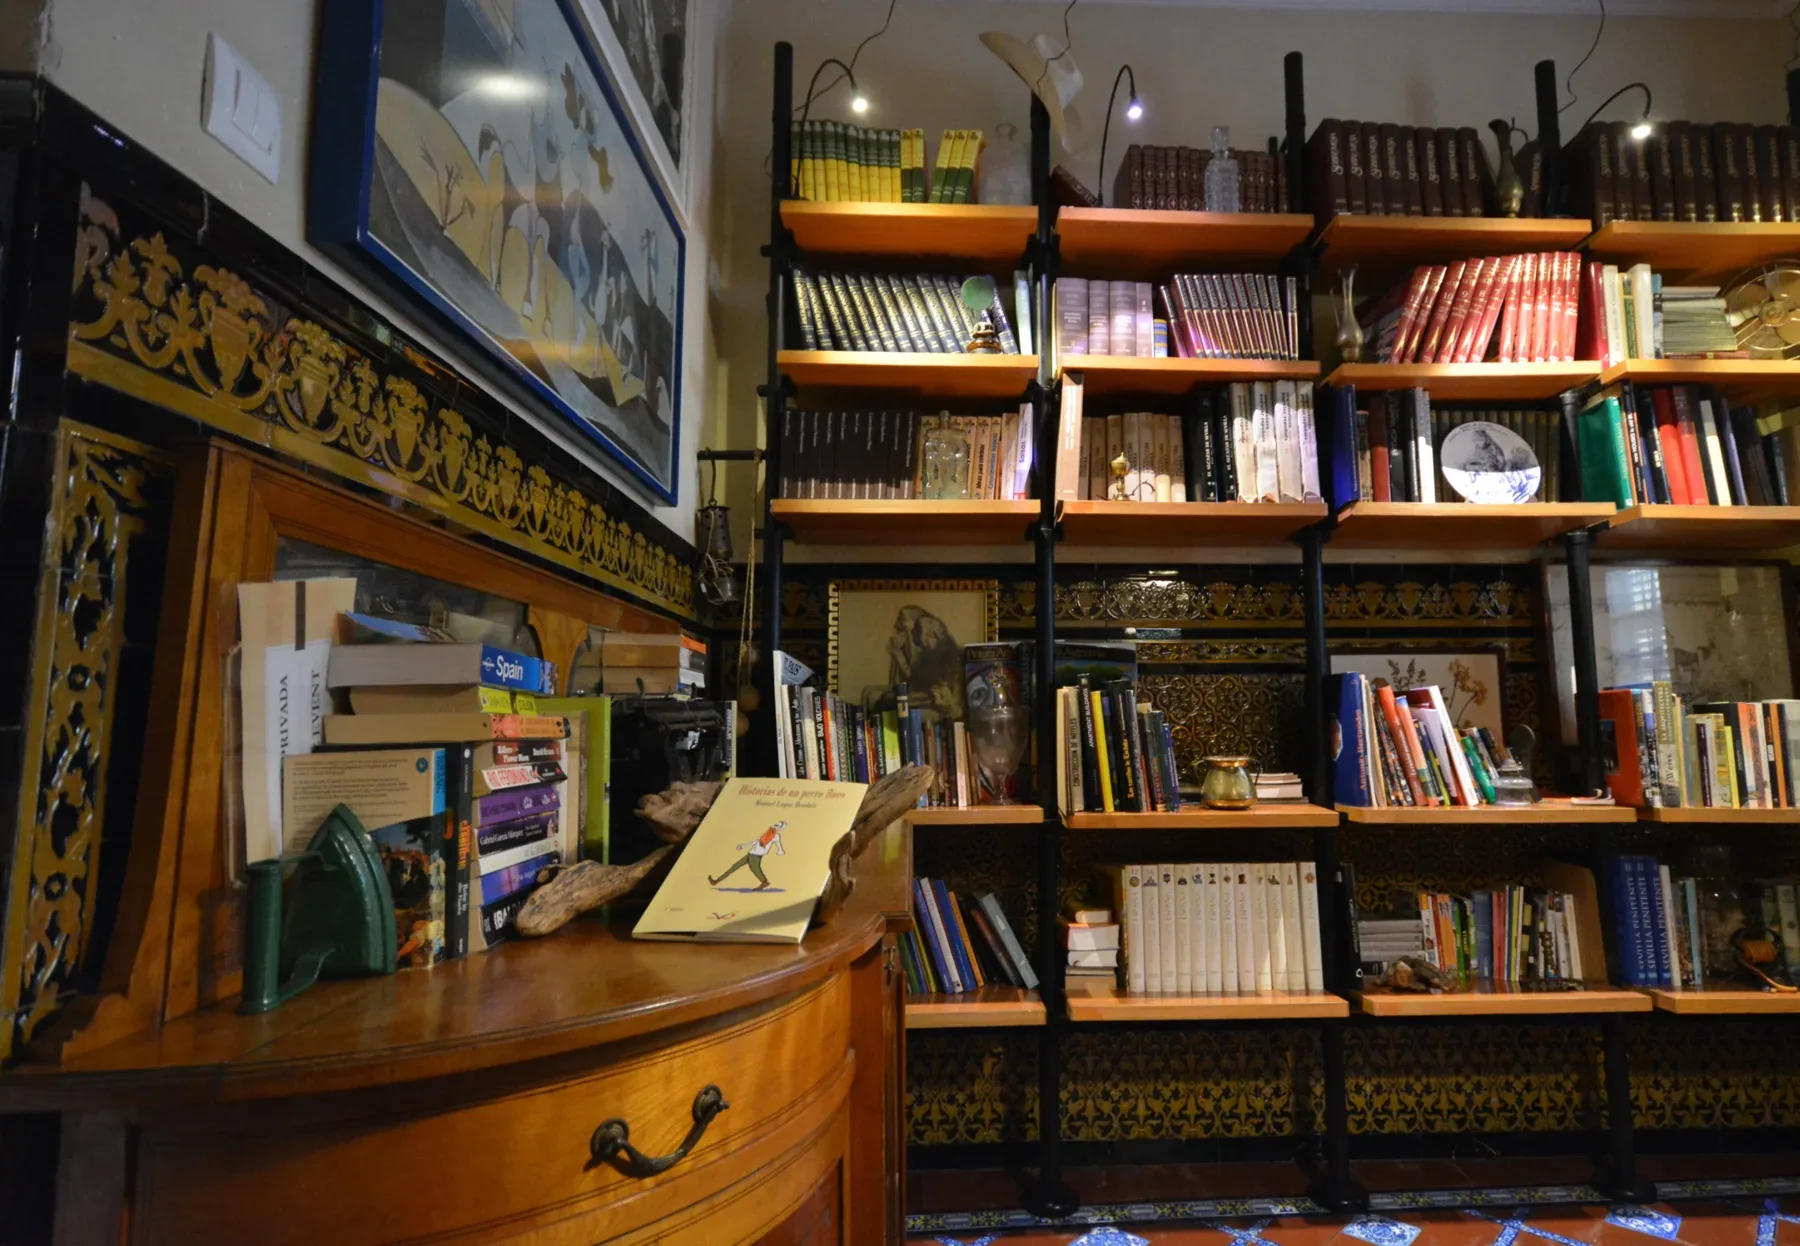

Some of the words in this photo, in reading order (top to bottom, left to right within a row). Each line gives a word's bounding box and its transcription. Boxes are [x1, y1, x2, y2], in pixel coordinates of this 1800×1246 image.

[1018, 440, 1026, 464] Salsas
[496, 655, 523, 682] Spain
[311, 669, 320, 737] EVENT
[814, 696, 823, 722] VOLCANES
[1082, 687, 1092, 716] BUILDINGS
[817, 723, 825, 738] BAJO
[1085, 717, 1095, 748] APARTMENT
[738, 785, 775, 796] Historias
[777, 786, 787, 797] de
[788, 790, 800, 798] un
[1627, 876, 1641, 929] PENITENTE
[1638, 875, 1652, 929] PENITENTE
[1653, 875, 1667, 929] PENITENTE
[1634, 932, 1645, 970] SEVILLA
[1644, 931, 1657, 970] SEVILLA
[1660, 931, 1671, 970] SEVILLA
